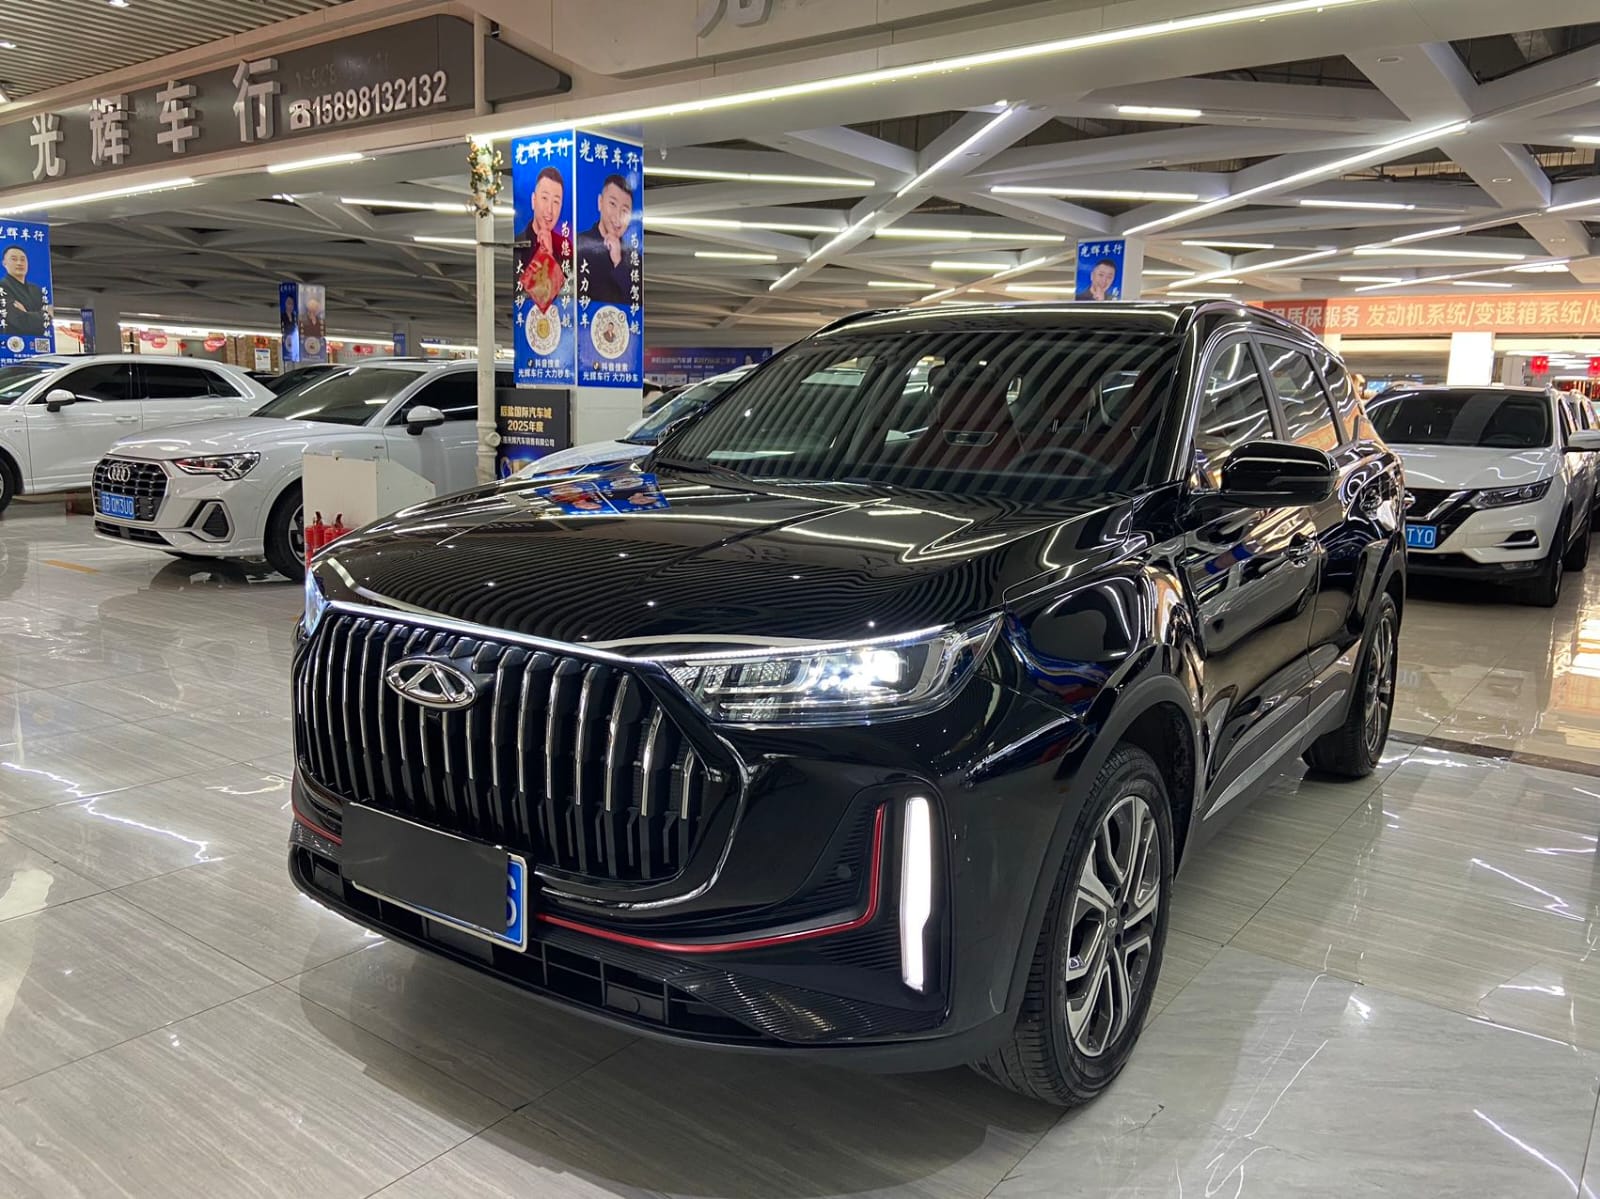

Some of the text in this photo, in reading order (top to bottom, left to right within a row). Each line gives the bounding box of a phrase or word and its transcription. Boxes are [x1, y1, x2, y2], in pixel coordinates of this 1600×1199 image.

[30, 58, 281, 181] 光辉车行
[312, 70, 447, 126] 15898132132
[515, 137, 572, 165] 光辉车行
[580, 138, 640, 172] 光辉车行
